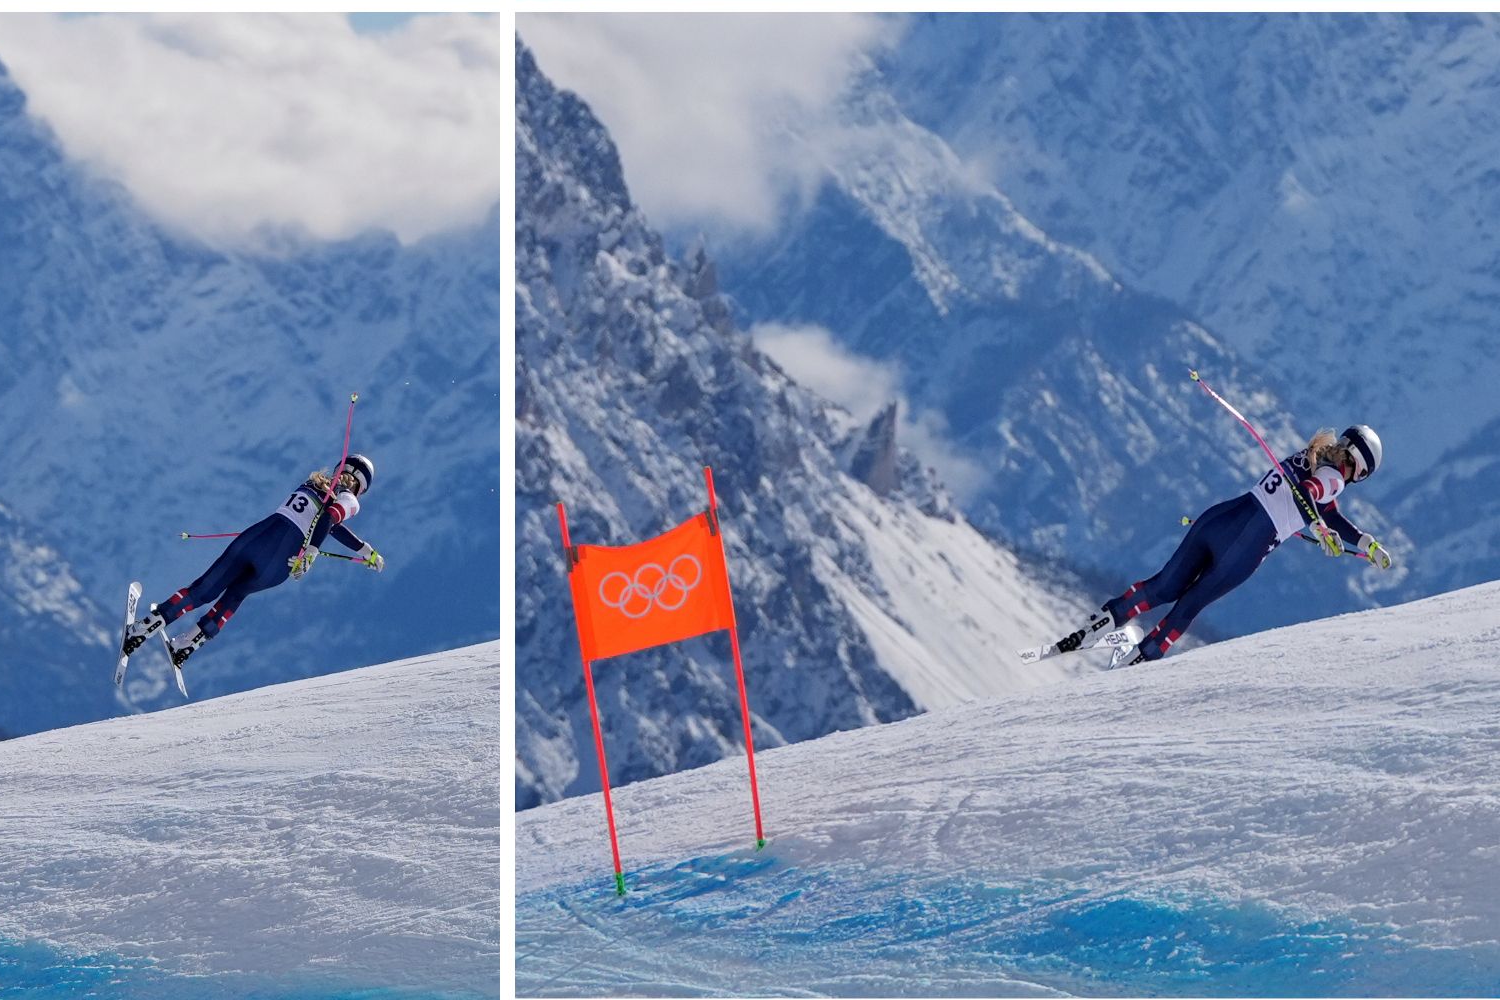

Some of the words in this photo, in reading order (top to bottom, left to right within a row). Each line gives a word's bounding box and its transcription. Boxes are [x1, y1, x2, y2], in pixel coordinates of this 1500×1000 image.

[1260, 469, 1283, 495] 13
[285, 493, 309, 513] 13
[1105, 632, 1129, 646] HEAD
